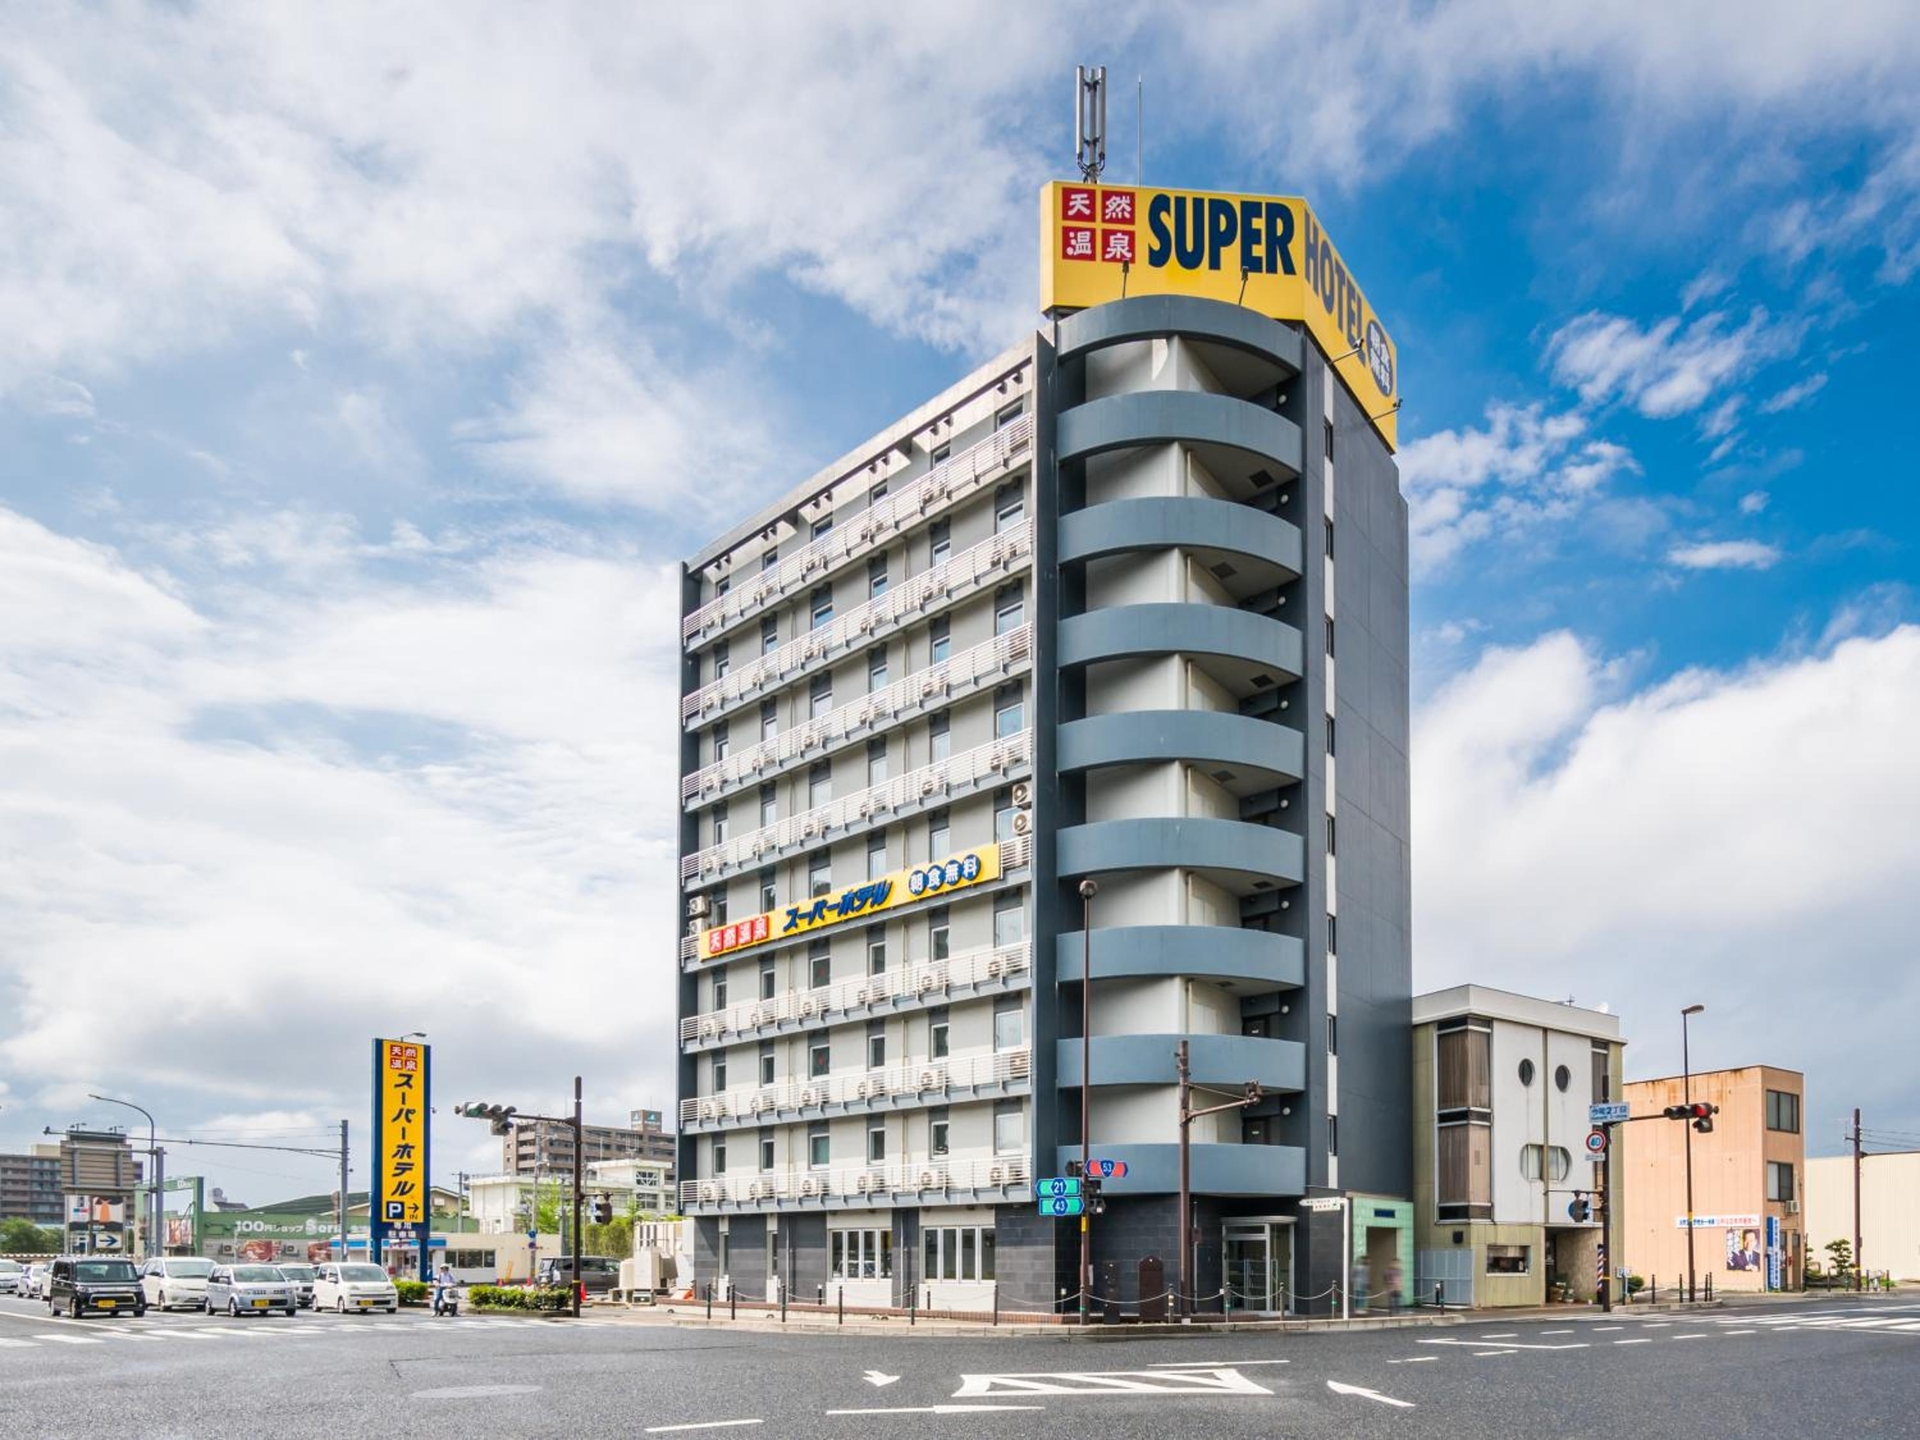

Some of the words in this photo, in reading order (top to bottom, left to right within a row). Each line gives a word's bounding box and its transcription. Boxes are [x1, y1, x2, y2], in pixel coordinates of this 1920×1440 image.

[1067, 193, 1132, 220] 天然
[1065, 230, 1133, 260] 温泉
[1147, 193, 1298, 276] SUPER
[1304, 208, 1367, 368] HOTEL
[782, 879, 894, 933] スーパーホテル
[908, 855, 979, 895] 朝食無料
[391, 1073, 417, 1198] スーパーホテル
[1102, 1162, 1112, 1173] 53
[1053, 1182, 1064, 1194] 21
[388, 1202, 402, 1218] P
[1055, 1200, 1066, 1211] 43
